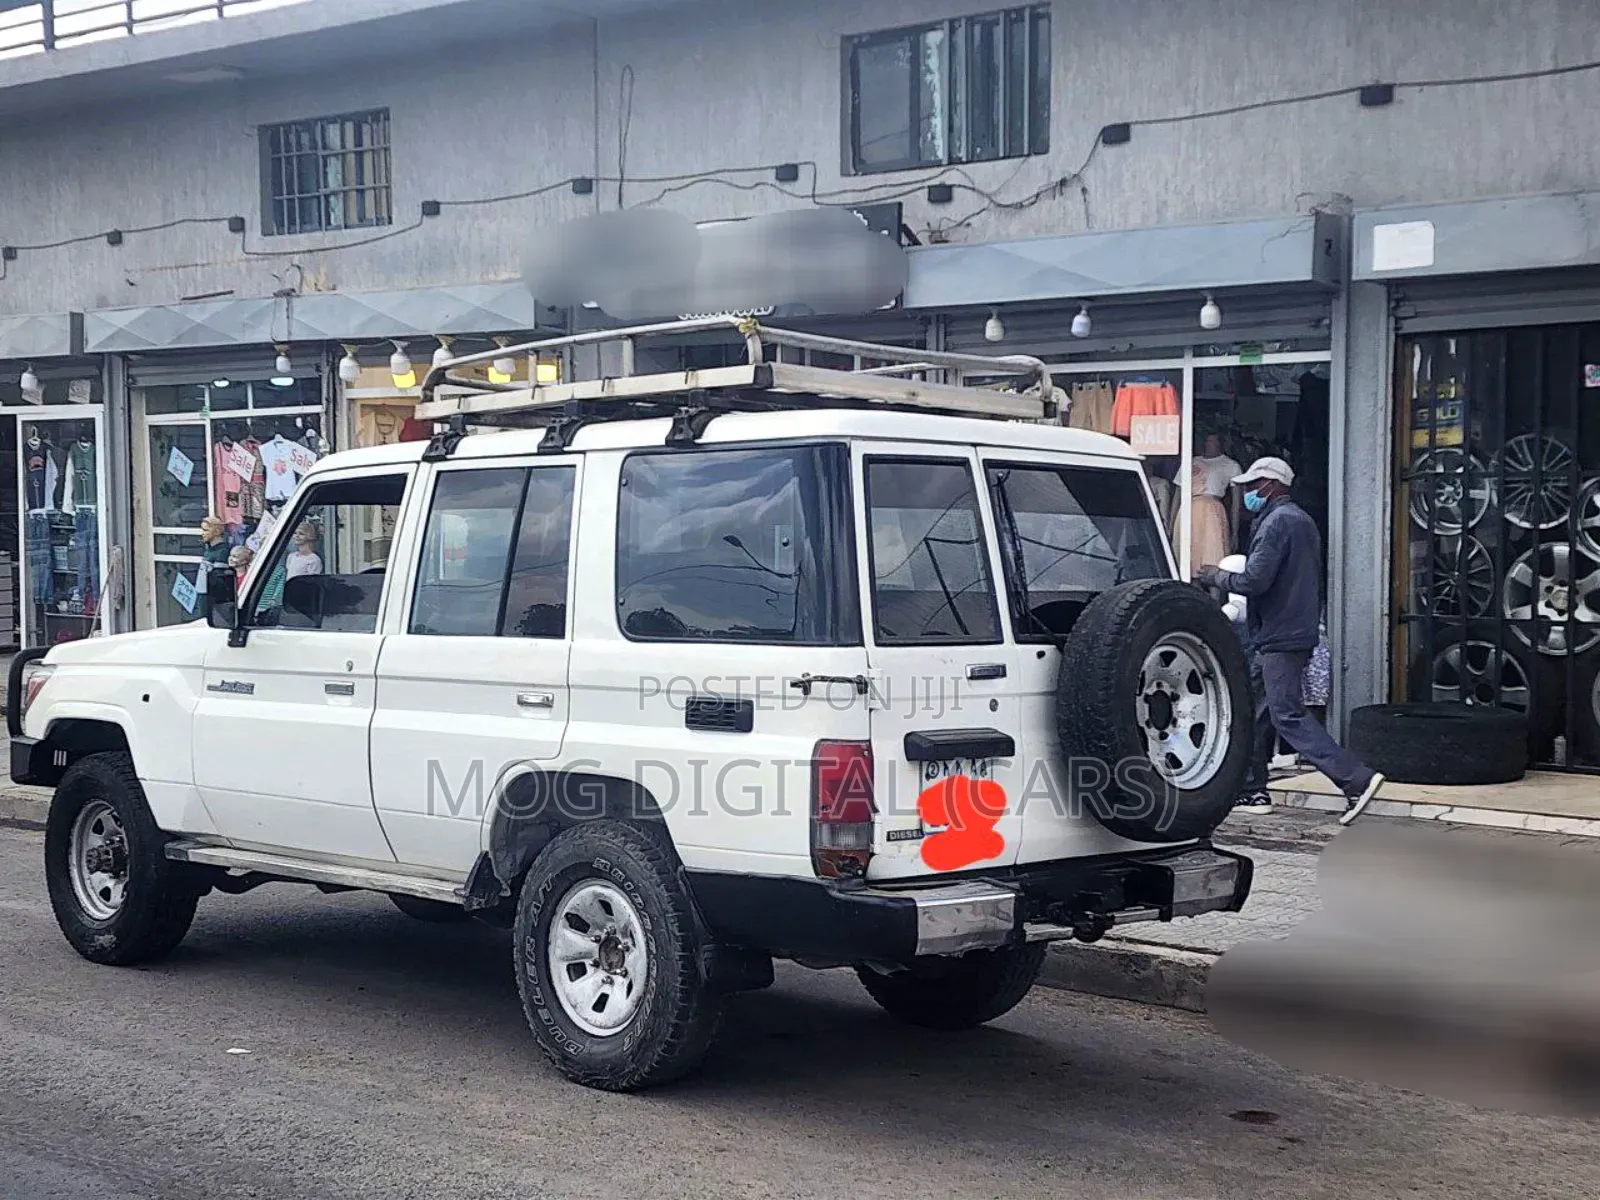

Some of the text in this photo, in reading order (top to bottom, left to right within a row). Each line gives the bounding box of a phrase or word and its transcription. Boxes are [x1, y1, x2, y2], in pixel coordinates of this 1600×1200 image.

[1135, 423, 1177, 445] SALE
[230, 448, 253, 474] Sale
[289, 448, 314, 471] Sale
[889, 830, 923, 841] DIESEL
